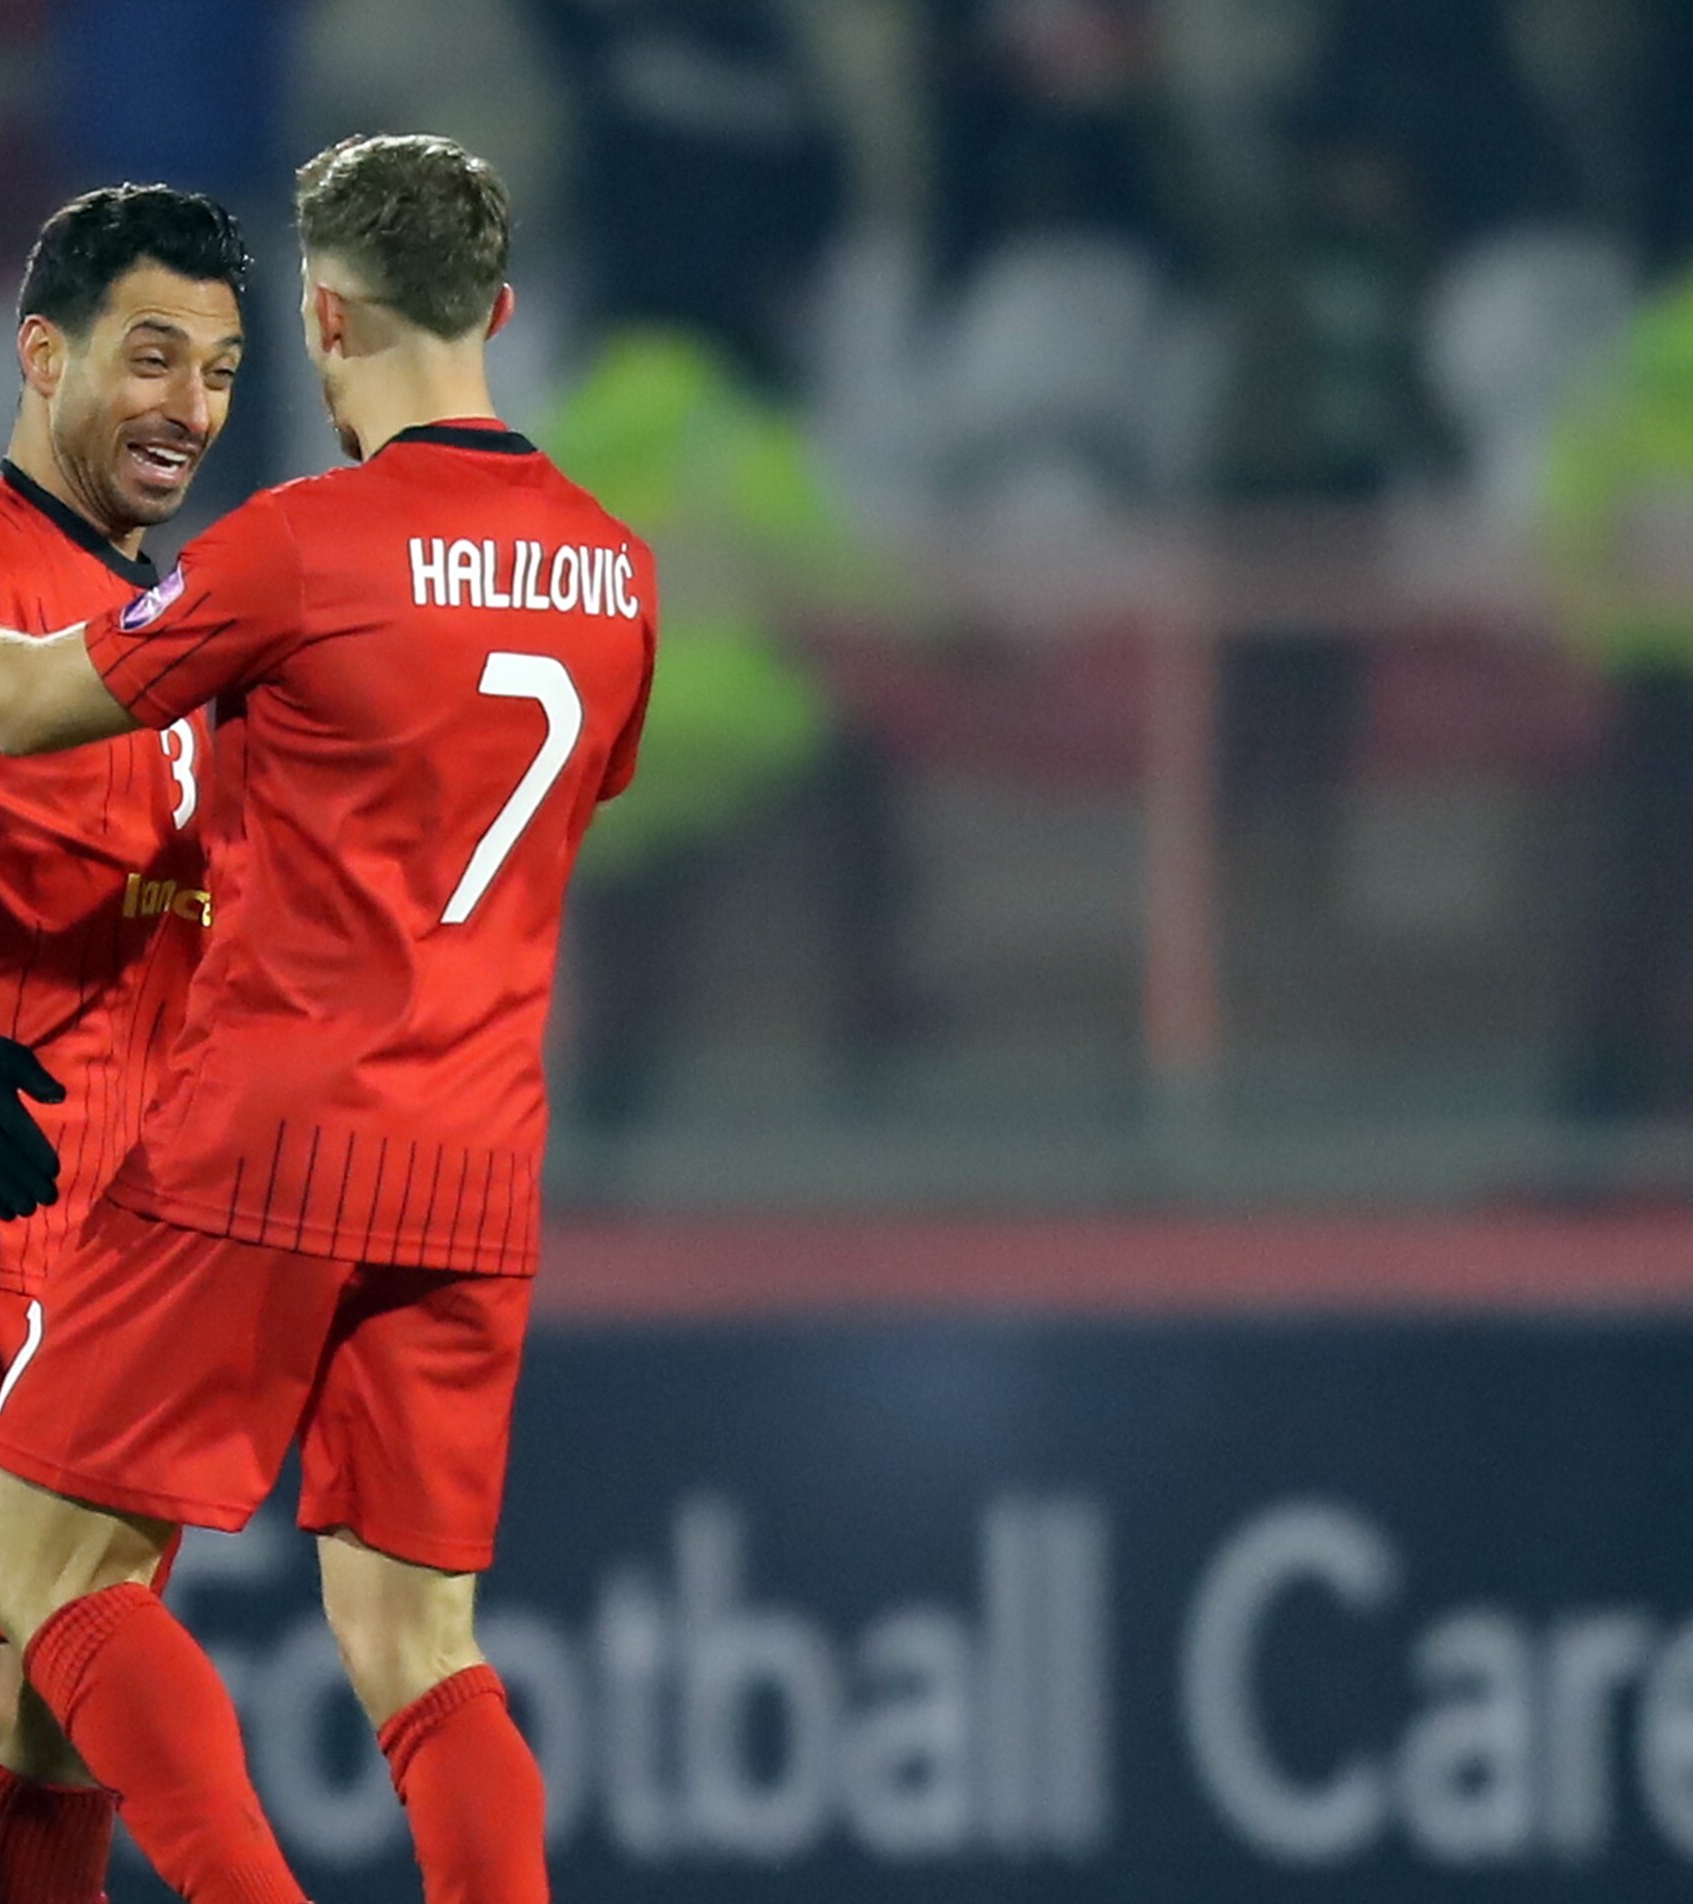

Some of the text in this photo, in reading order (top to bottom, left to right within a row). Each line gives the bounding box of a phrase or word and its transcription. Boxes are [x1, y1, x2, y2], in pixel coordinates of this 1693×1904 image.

[409, 536, 639, 619] HALILOVIĆ
[159, 717, 197, 831] 3
[439, 651, 584, 924] 7
